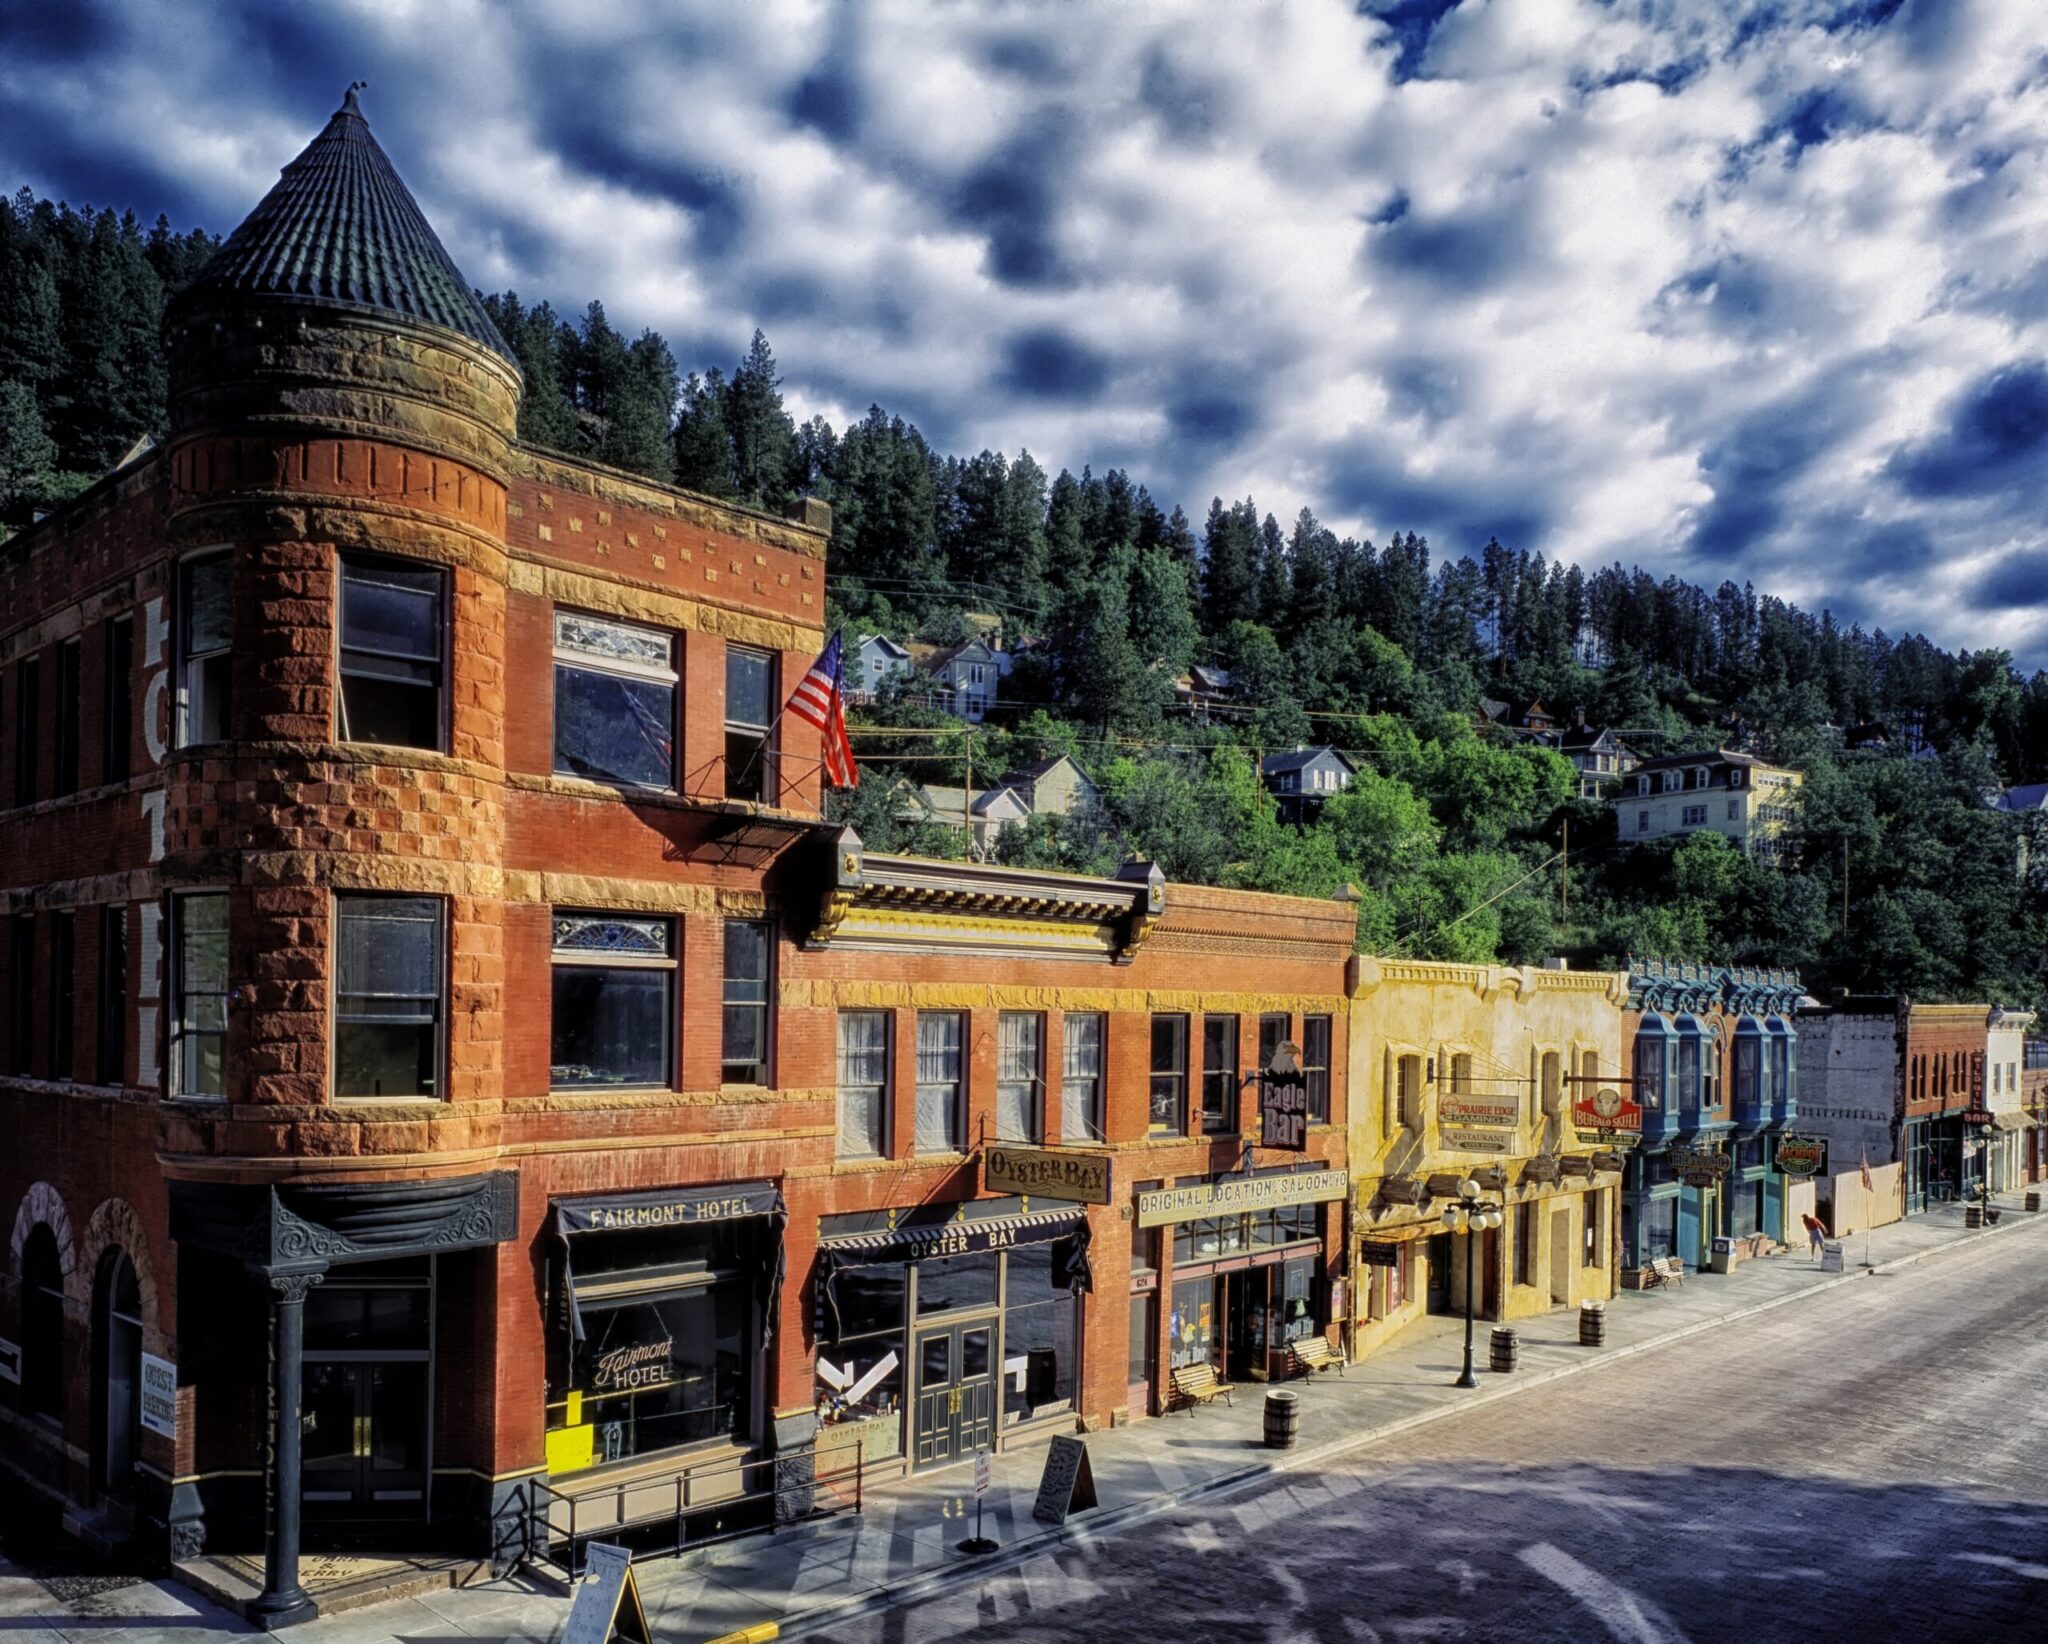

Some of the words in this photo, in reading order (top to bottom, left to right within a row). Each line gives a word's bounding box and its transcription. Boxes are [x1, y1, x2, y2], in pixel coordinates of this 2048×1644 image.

[1264, 1082, 1305, 1112] Eagle
[1459, 1104, 1492, 1115] PRAIRIE
[1494, 1106, 1515, 1116] EDGE
[1263, 1108, 1304, 1145] Bar
[1453, 1115, 1500, 1123] GAMING
[1576, 1110, 1611, 1126] BUFFALO
[1612, 1113, 1639, 1128] SKULL
[1453, 1133, 1504, 1142] RESTAURANT
[991, 1151, 1063, 1182] OYSTER
[1065, 1162, 1104, 1189] BAY
[1141, 1193, 1201, 1213] ORIGINAL
[1207, 1180, 1271, 1201] LOCATION
[590, 1203, 686, 1227] FAIRMONT
[697, 1199, 752, 1218] HOTEL
[911, 1237, 968, 1257] OYSTER
[989, 1229, 1015, 1247] BAY
[595, 1340, 672, 1385] Fairmont
[615, 1365, 669, 1388] HOTEL
